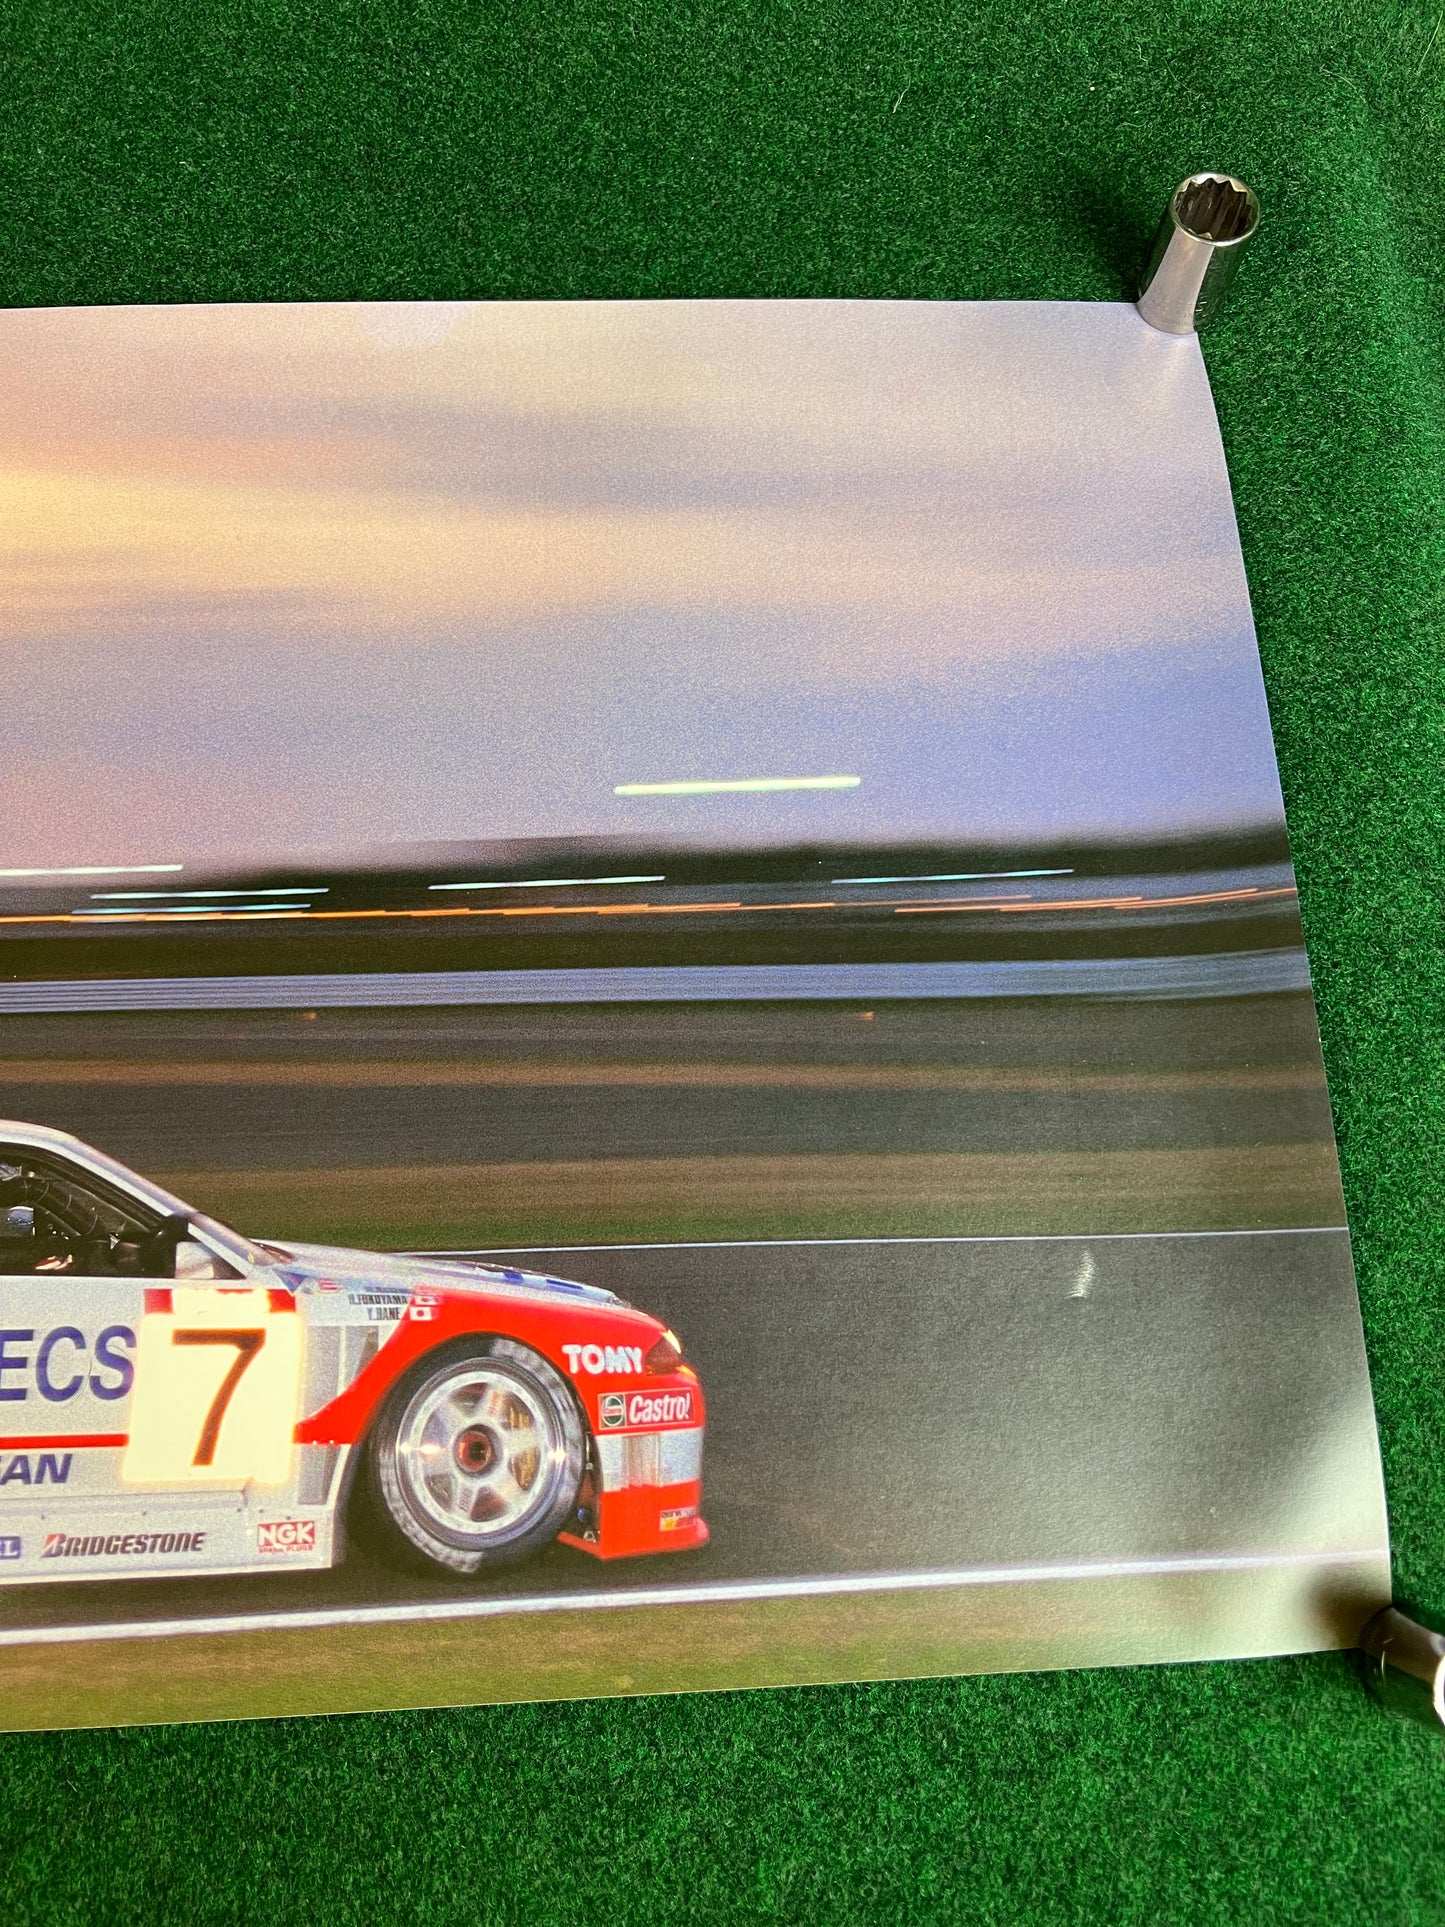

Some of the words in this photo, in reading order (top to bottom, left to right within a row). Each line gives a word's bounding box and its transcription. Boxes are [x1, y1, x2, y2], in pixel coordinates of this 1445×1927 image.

[561, 1344, 643, 1375] TOMY
[172, 1328, 267, 1466] 7
[0, 1454, 73, 1485] AN
[41, 1533, 206, 1558] BRIDGESTONE
[258, 1522, 314, 1549] NGK
